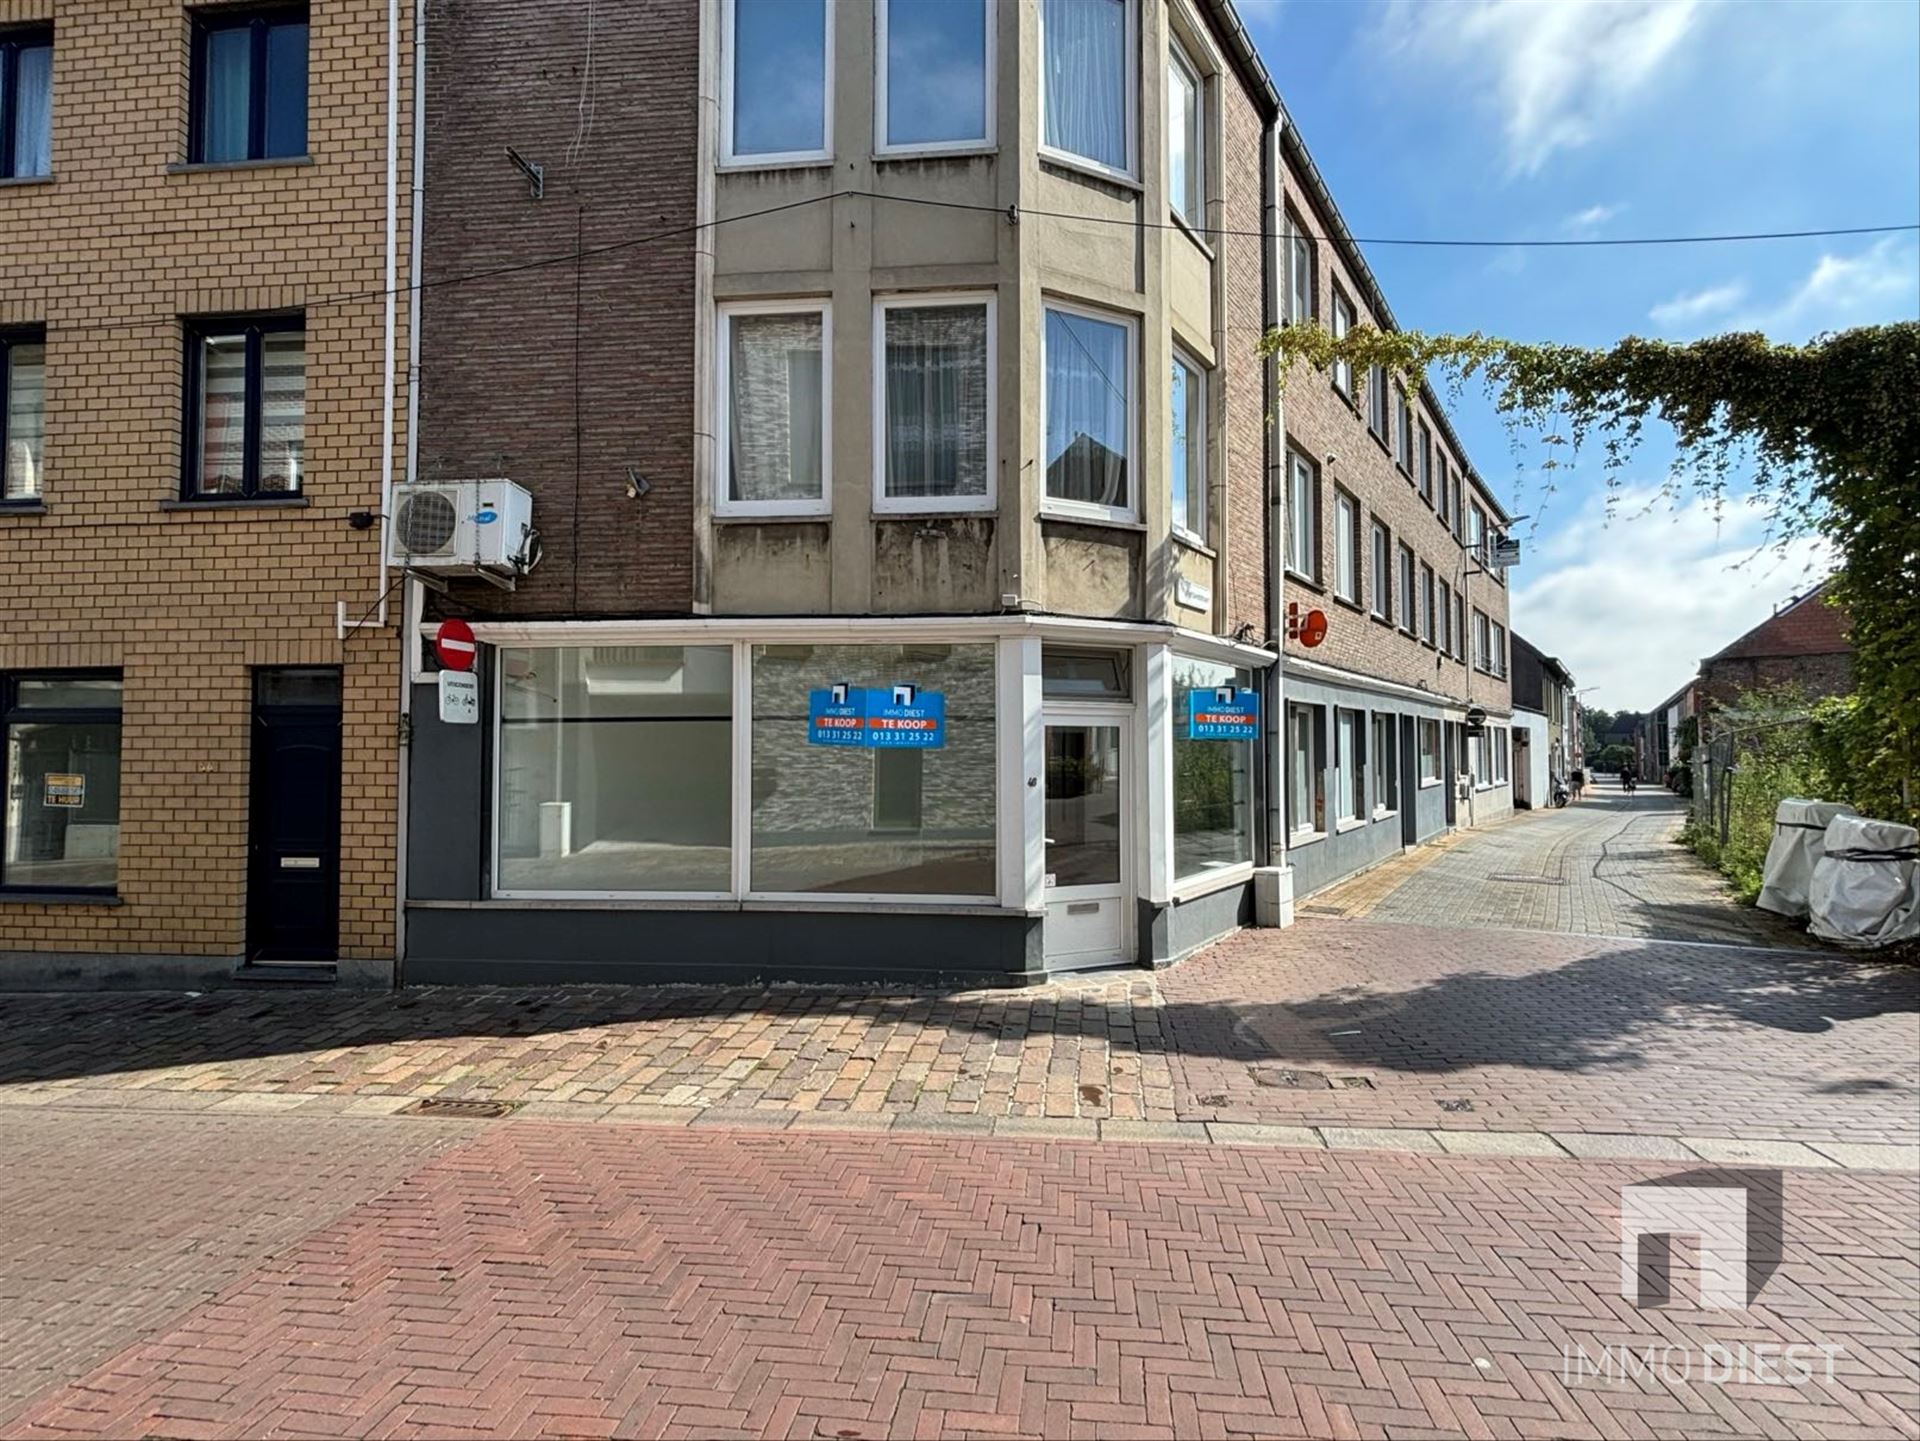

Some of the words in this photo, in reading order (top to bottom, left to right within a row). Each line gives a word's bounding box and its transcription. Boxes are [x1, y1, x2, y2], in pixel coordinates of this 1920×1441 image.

[904, 709, 925, 718] DIEST
[824, 718, 833, 727] TE
[834, 718, 857, 728] KOOP
[882, 719, 895, 729] TE
[897, 720, 927, 729] KOOP
[1205, 715, 1216, 723] TE
[1219, 715, 1247, 723] KOOP
[1198, 724, 1214, 733] 013
[1217, 725, 1227, 733] 31
[1230, 725, 1240, 733] 25
[1242, 726, 1253, 734] 22
[817, 730, 830, 738] 013
[832, 730, 840, 739] 31
[842, 731, 852, 739] 25
[853, 731, 862, 740] 22
[872, 731, 891, 741] 013
[895, 732, 905, 741] 31
[909, 732, 920, 741] 25
[924, 732, 934, 741] 22
